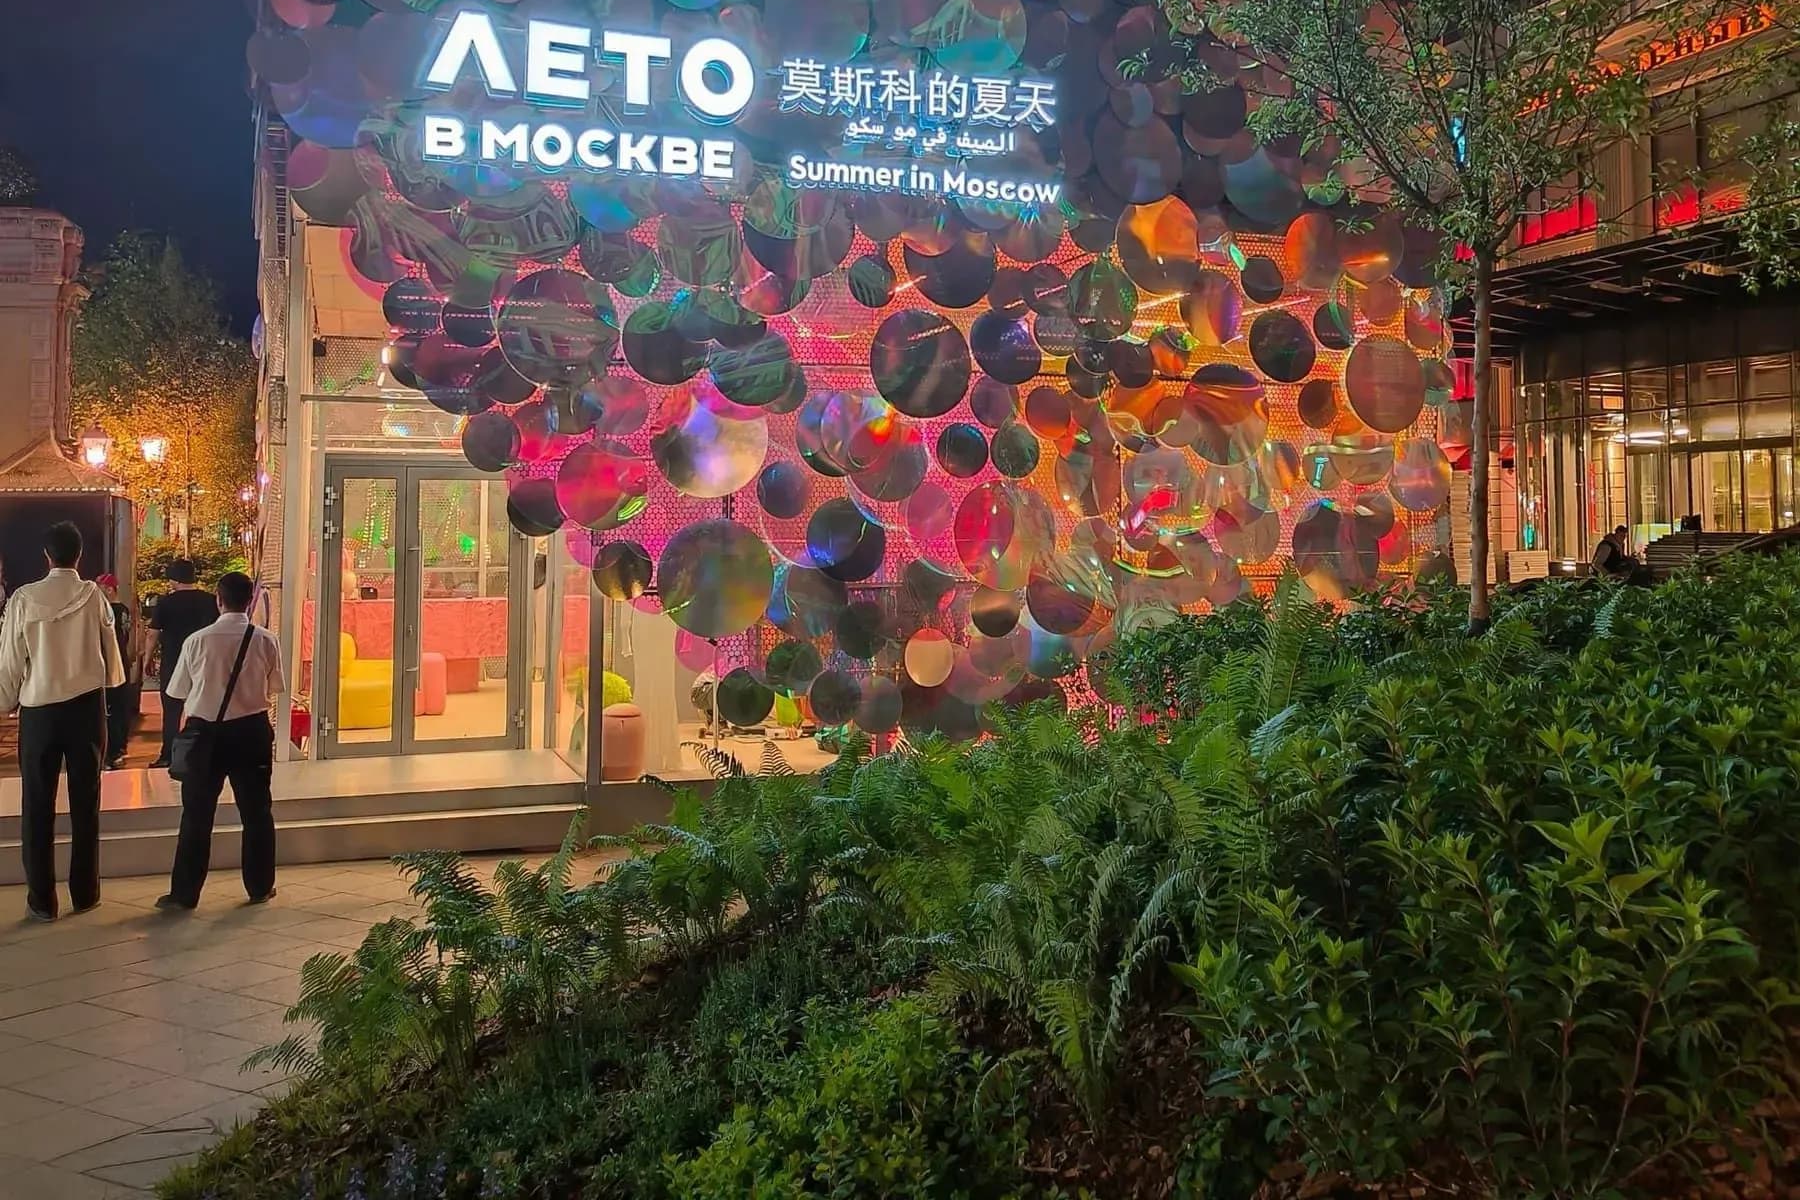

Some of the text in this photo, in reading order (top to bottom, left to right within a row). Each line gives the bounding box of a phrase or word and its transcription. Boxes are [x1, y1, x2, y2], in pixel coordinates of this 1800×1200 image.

[426, 10, 755, 117] ЛЕТО
[781, 58, 1057, 127] 莫斯科的夏天
[424, 115, 735, 179] В МОСКВЕ
[922, 127, 948, 152] في
[955, 131, 1015, 153] الصيف
[788, 154, 1061, 204] Summer in Moscow
